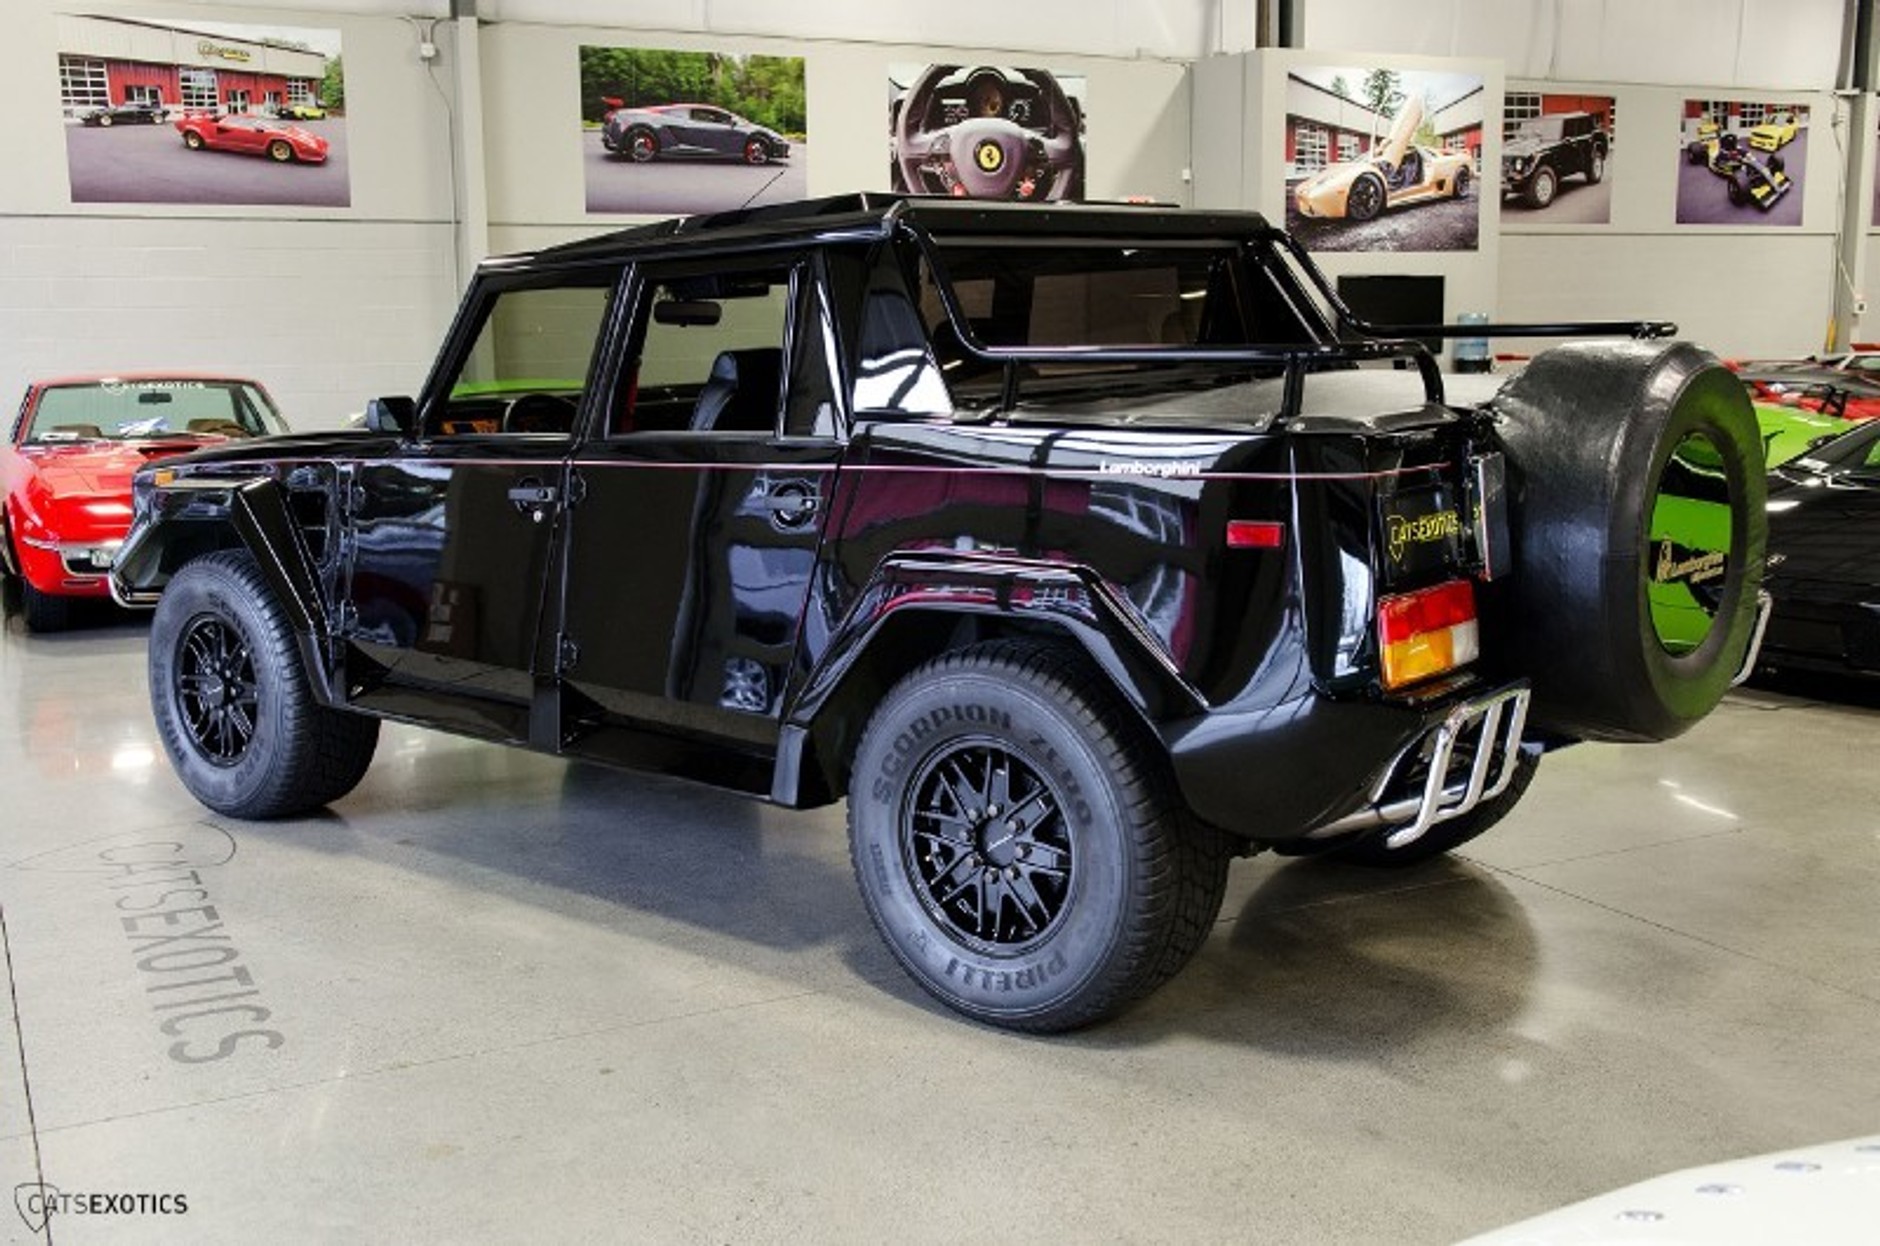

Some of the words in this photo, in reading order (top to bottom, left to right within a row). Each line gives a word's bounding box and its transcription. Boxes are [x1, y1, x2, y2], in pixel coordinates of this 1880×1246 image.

[1100, 461, 1201, 478] Lamborghini
[872, 703, 1012, 805] SCORPION
[944, 950, 1067, 989] PIRELLI
